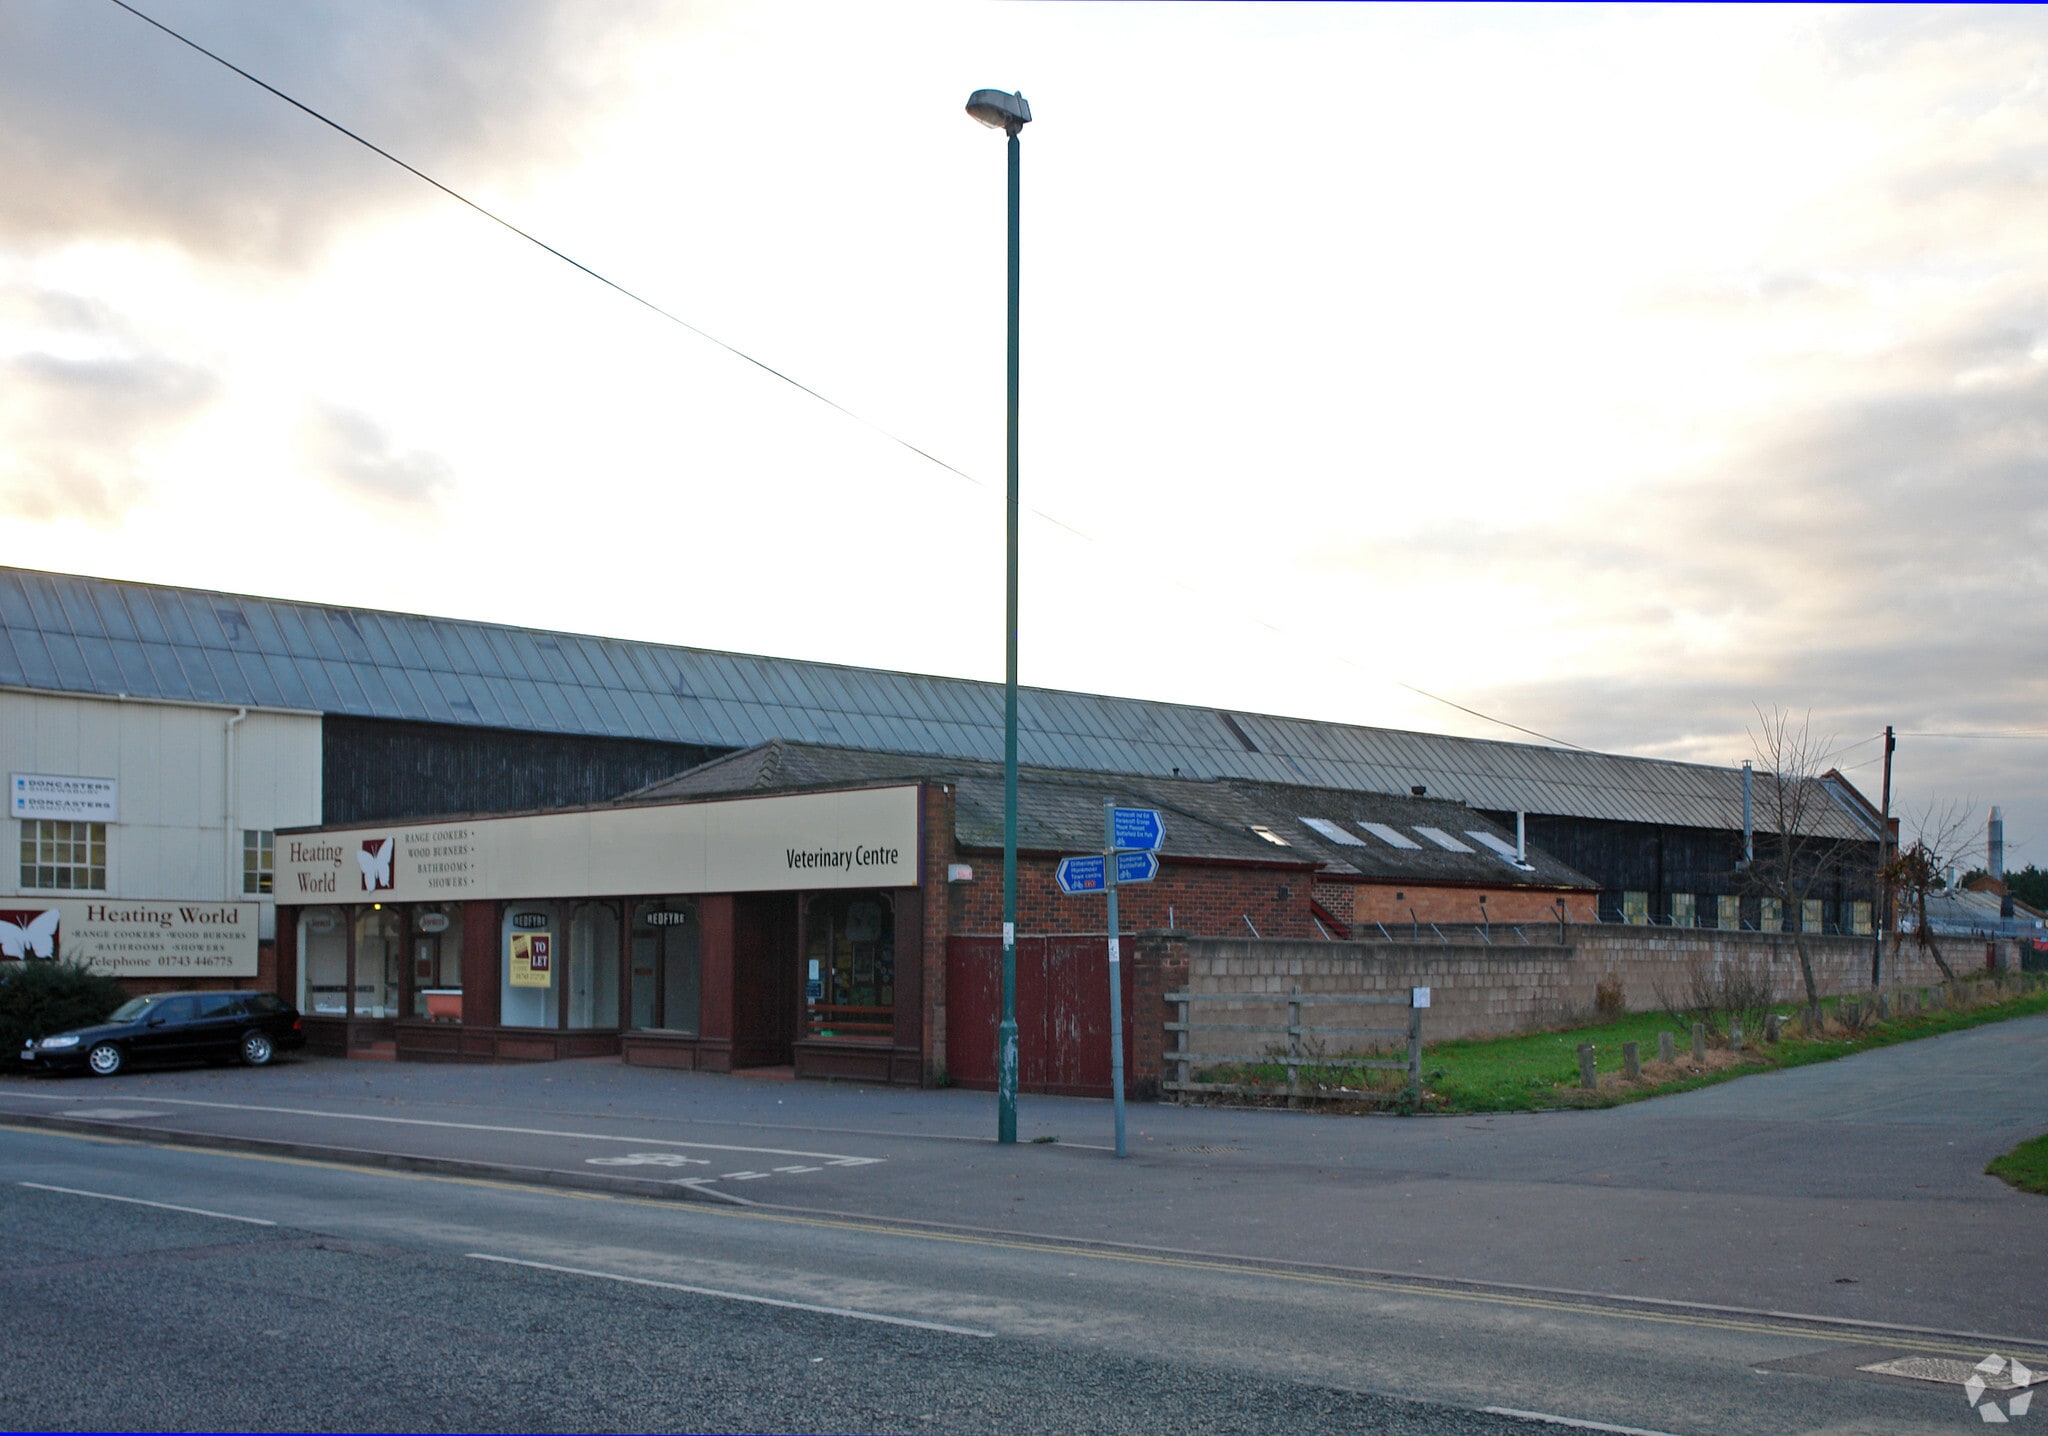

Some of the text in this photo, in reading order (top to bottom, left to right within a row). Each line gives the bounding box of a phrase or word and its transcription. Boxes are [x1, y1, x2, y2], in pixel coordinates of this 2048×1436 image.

[29, 780, 110, 790] DONCASTERS
[29, 786, 99, 794] SHREWSBURY
[29, 799, 110, 808] DONCASTERS
[405, 830, 467, 843] RANGE COOKERS
[290, 841, 343, 868] Heating
[408, 845, 467, 858] WOOD BURNERS
[786, 845, 898, 872] Veterinary Centre
[417, 862, 467, 873] BATHROOMS
[298, 873, 336, 893] World
[428, 877, 467, 888] SHOWERS
[87, 905, 239, 929] Heating World
[647, 912, 685, 926] REDFYRE
[114, 931, 161, 939] COOKERS
[203, 932, 246, 940] BURNERS
[534, 941, 546, 953] TO
[87, 955, 233, 968] Telephone 01743 446775
[532, 955, 548, 967] LET
